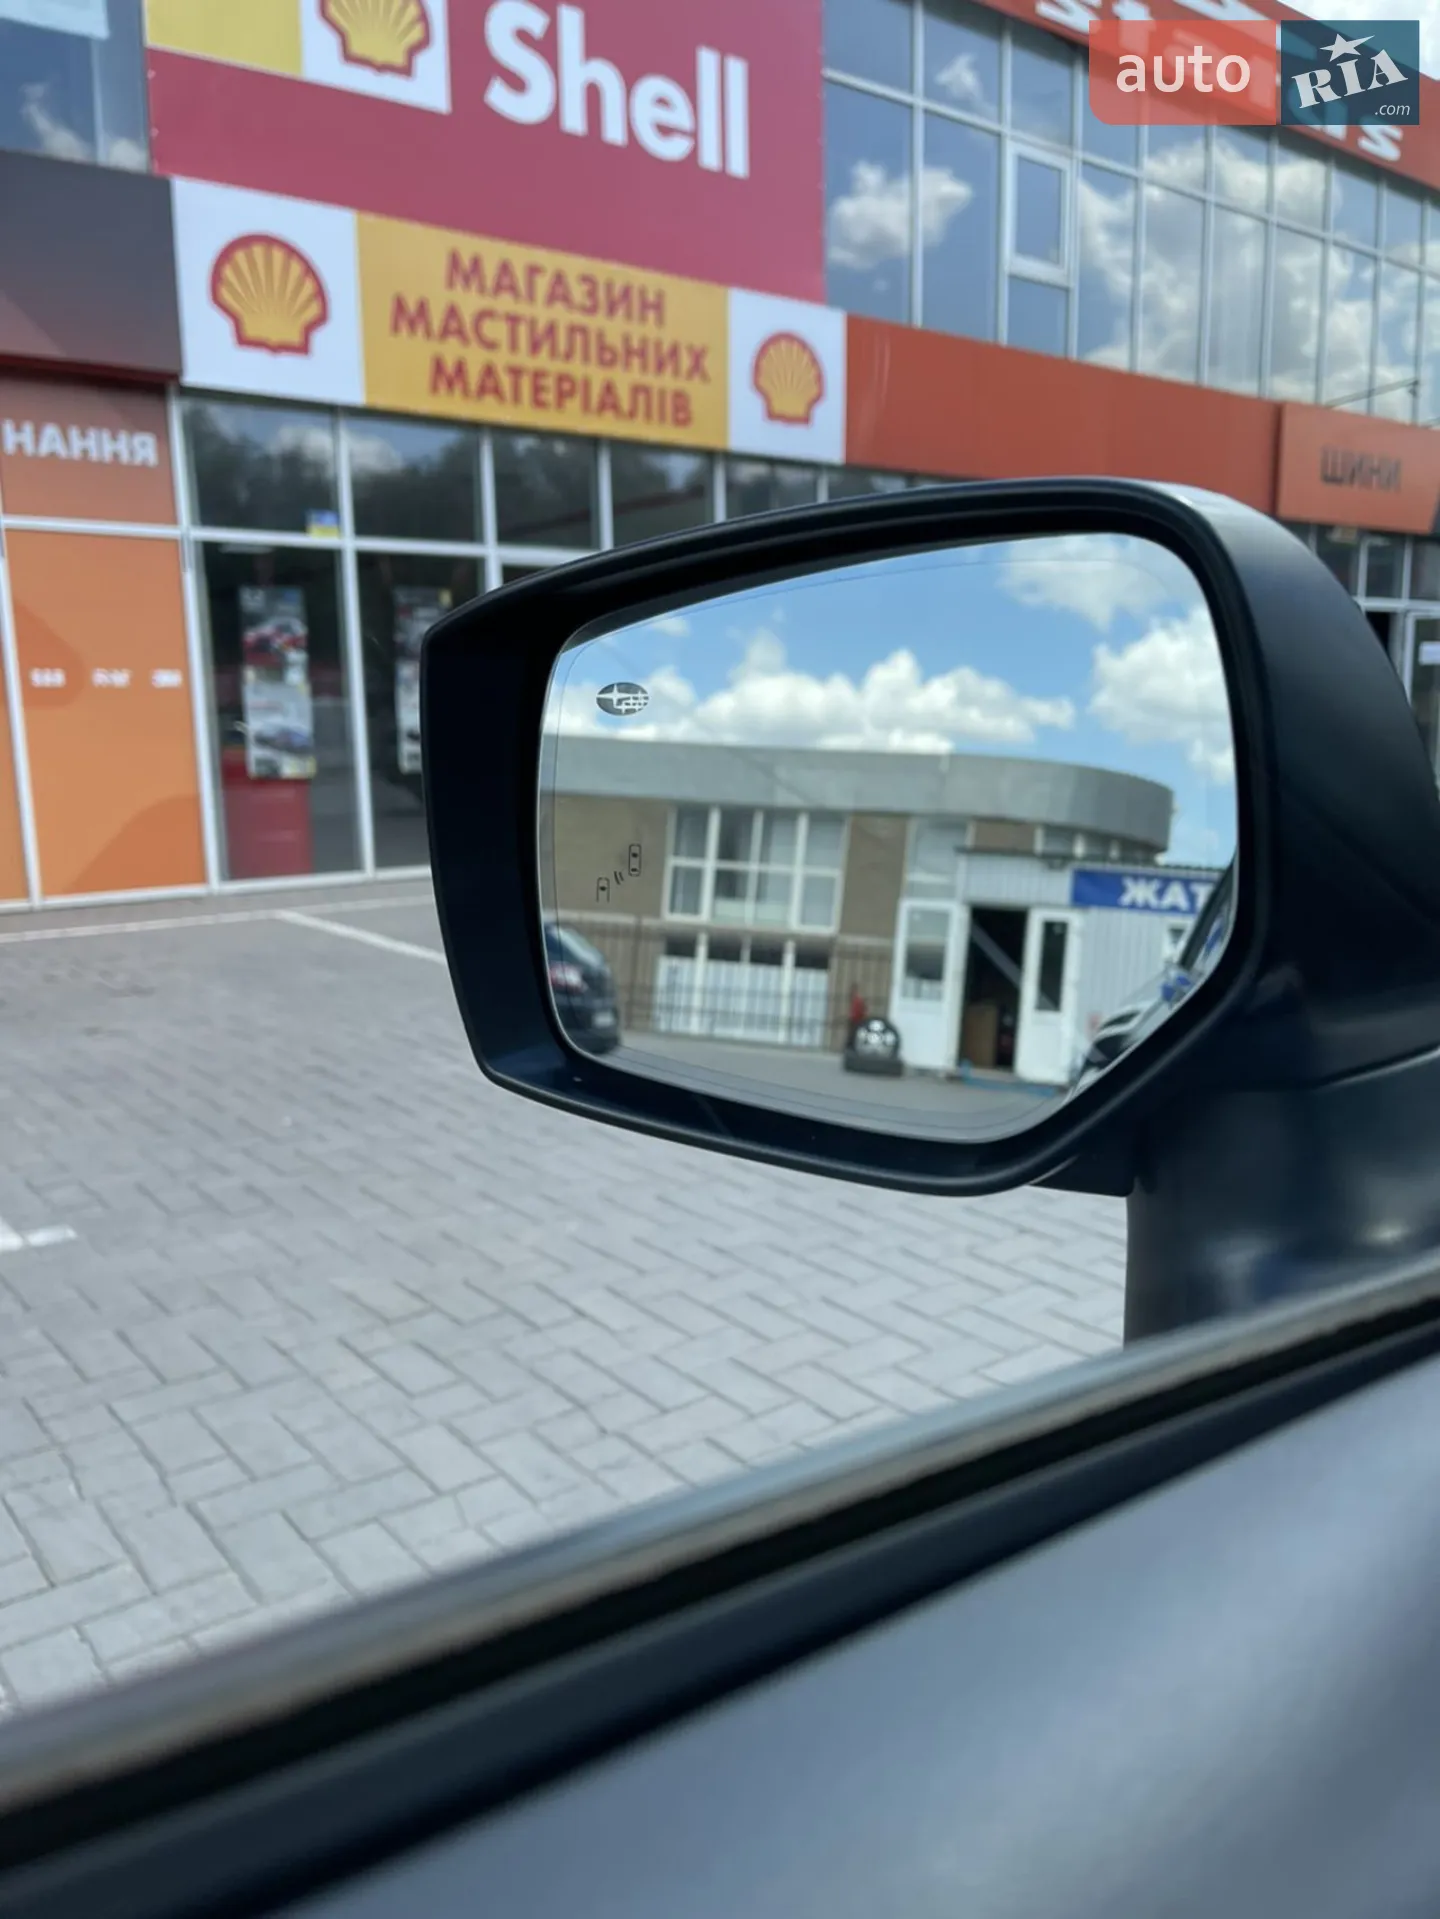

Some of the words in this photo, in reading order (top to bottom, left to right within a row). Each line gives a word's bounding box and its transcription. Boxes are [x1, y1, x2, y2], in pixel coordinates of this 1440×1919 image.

[485, 0, 750, 179] Shell
[445, 248, 665, 328] МАГАЗИН
[389, 293, 711, 382] МАСТИЛЬНИХ
[429, 355, 693, 427] МАТЕРІАЛІВ
[2, 418, 158, 468] НАННЯ
